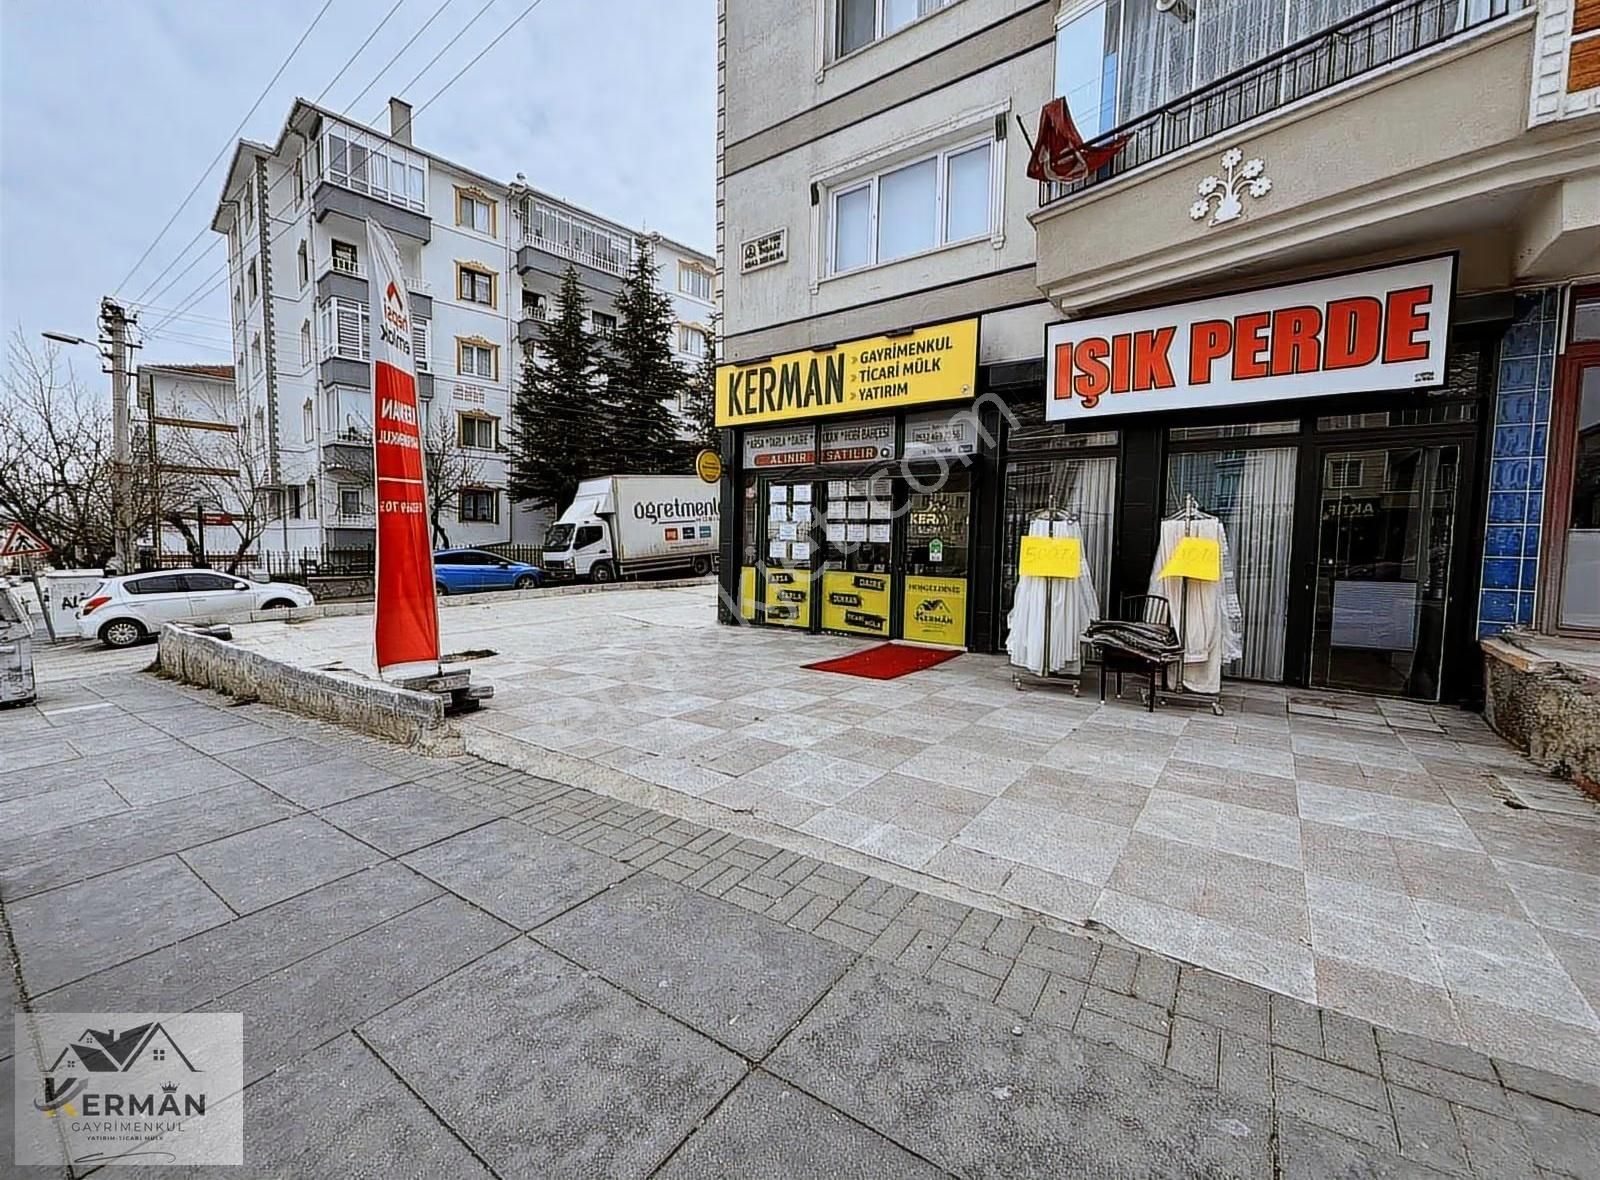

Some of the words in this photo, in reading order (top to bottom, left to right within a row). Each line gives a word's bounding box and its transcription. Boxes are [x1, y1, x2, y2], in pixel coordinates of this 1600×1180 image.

[860, 336, 953, 364] GAYRİMENKUL
[1054, 326, 1178, 409] IŞIK
[1188, 284, 1434, 386] PERDE
[859, 364, 899, 383] TİCARİ
[902, 357, 941, 377] MÜLK
[728, 353, 845, 417] KERMAN
[859, 382, 908, 401] YATIRIM
[770, 453, 807, 464] ALINIR
[826, 447, 874, 461] SATILIR
